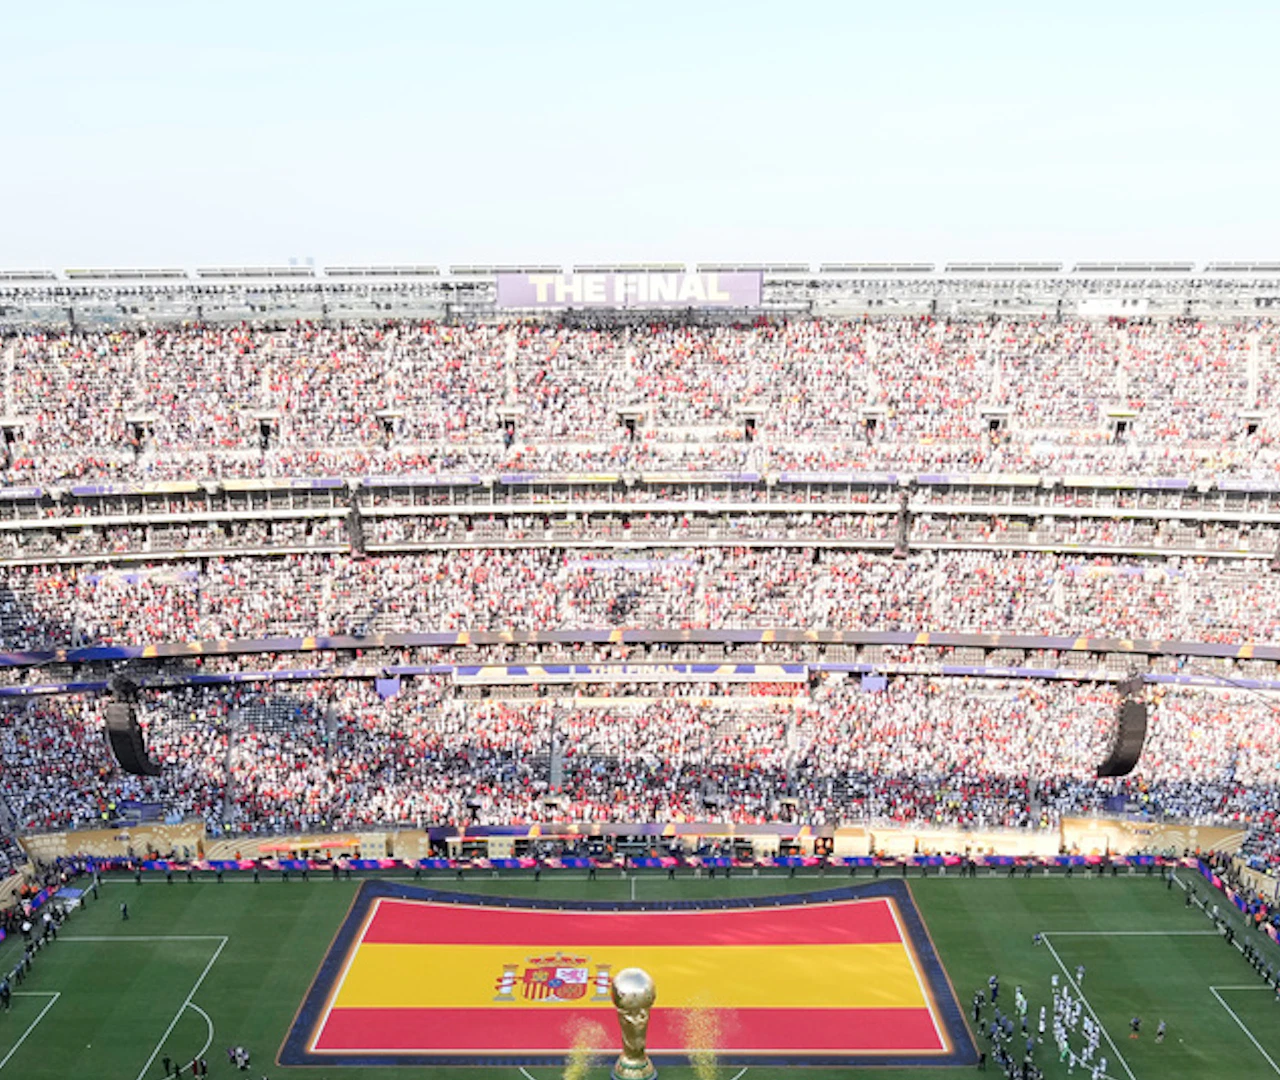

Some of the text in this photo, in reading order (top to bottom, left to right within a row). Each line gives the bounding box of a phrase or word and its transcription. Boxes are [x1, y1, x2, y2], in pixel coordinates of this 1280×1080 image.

[529, 275, 729, 302] THE FINAL
[589, 664, 680, 673] THE FINAL
